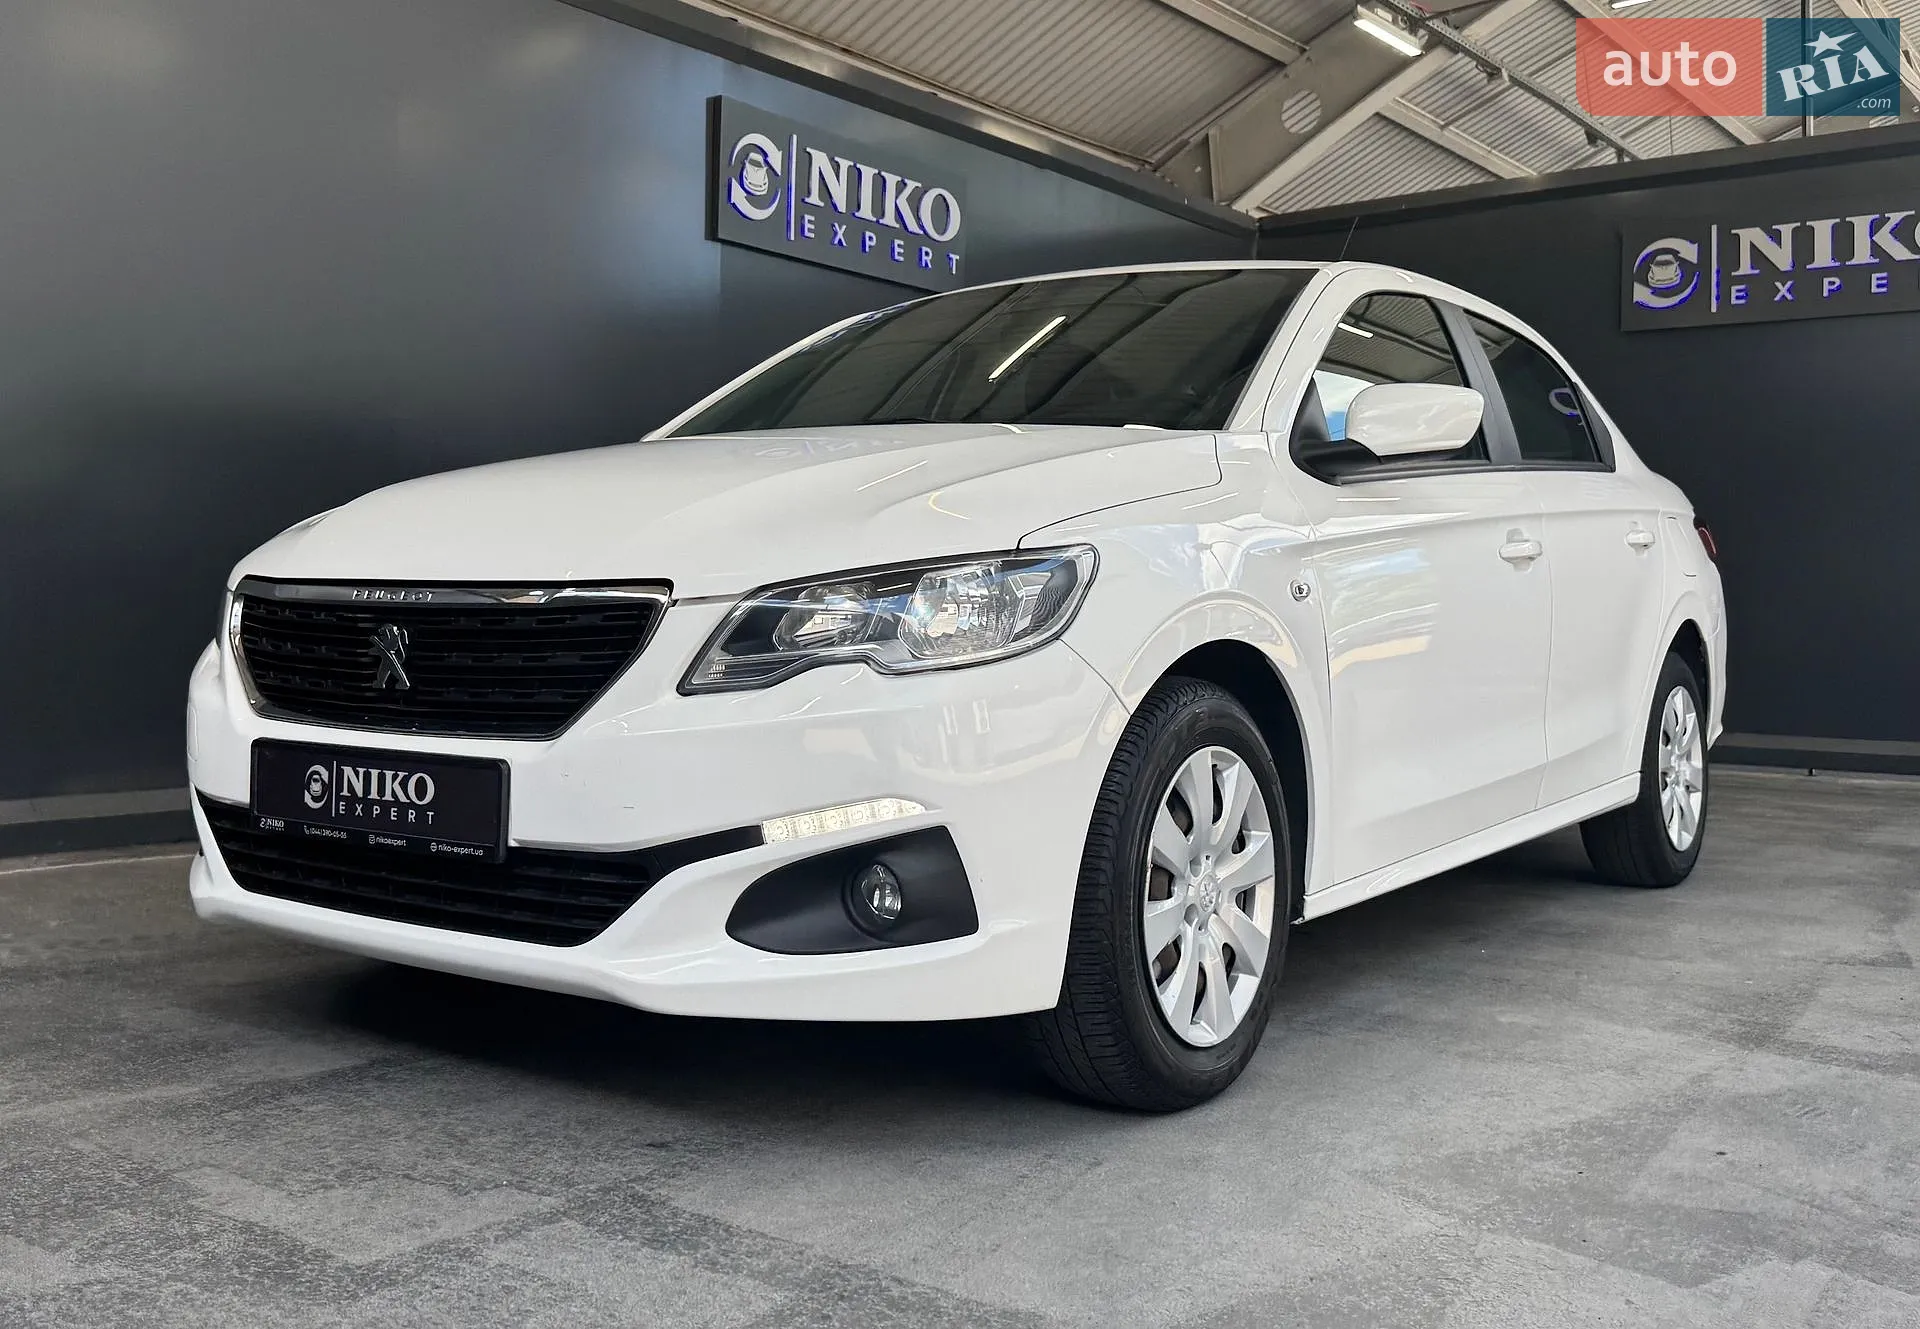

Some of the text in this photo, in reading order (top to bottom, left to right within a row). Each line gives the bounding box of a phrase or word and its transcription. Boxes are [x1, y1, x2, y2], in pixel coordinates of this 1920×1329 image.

[802, 146, 961, 243] NIKO
[801, 214, 960, 275] EXPERT
[1731, 209, 1920, 276] NIK
[1731, 271, 1920, 306] EXPE
[339, 765, 435, 805] NIKO
[339, 801, 435, 825] EXPERT
